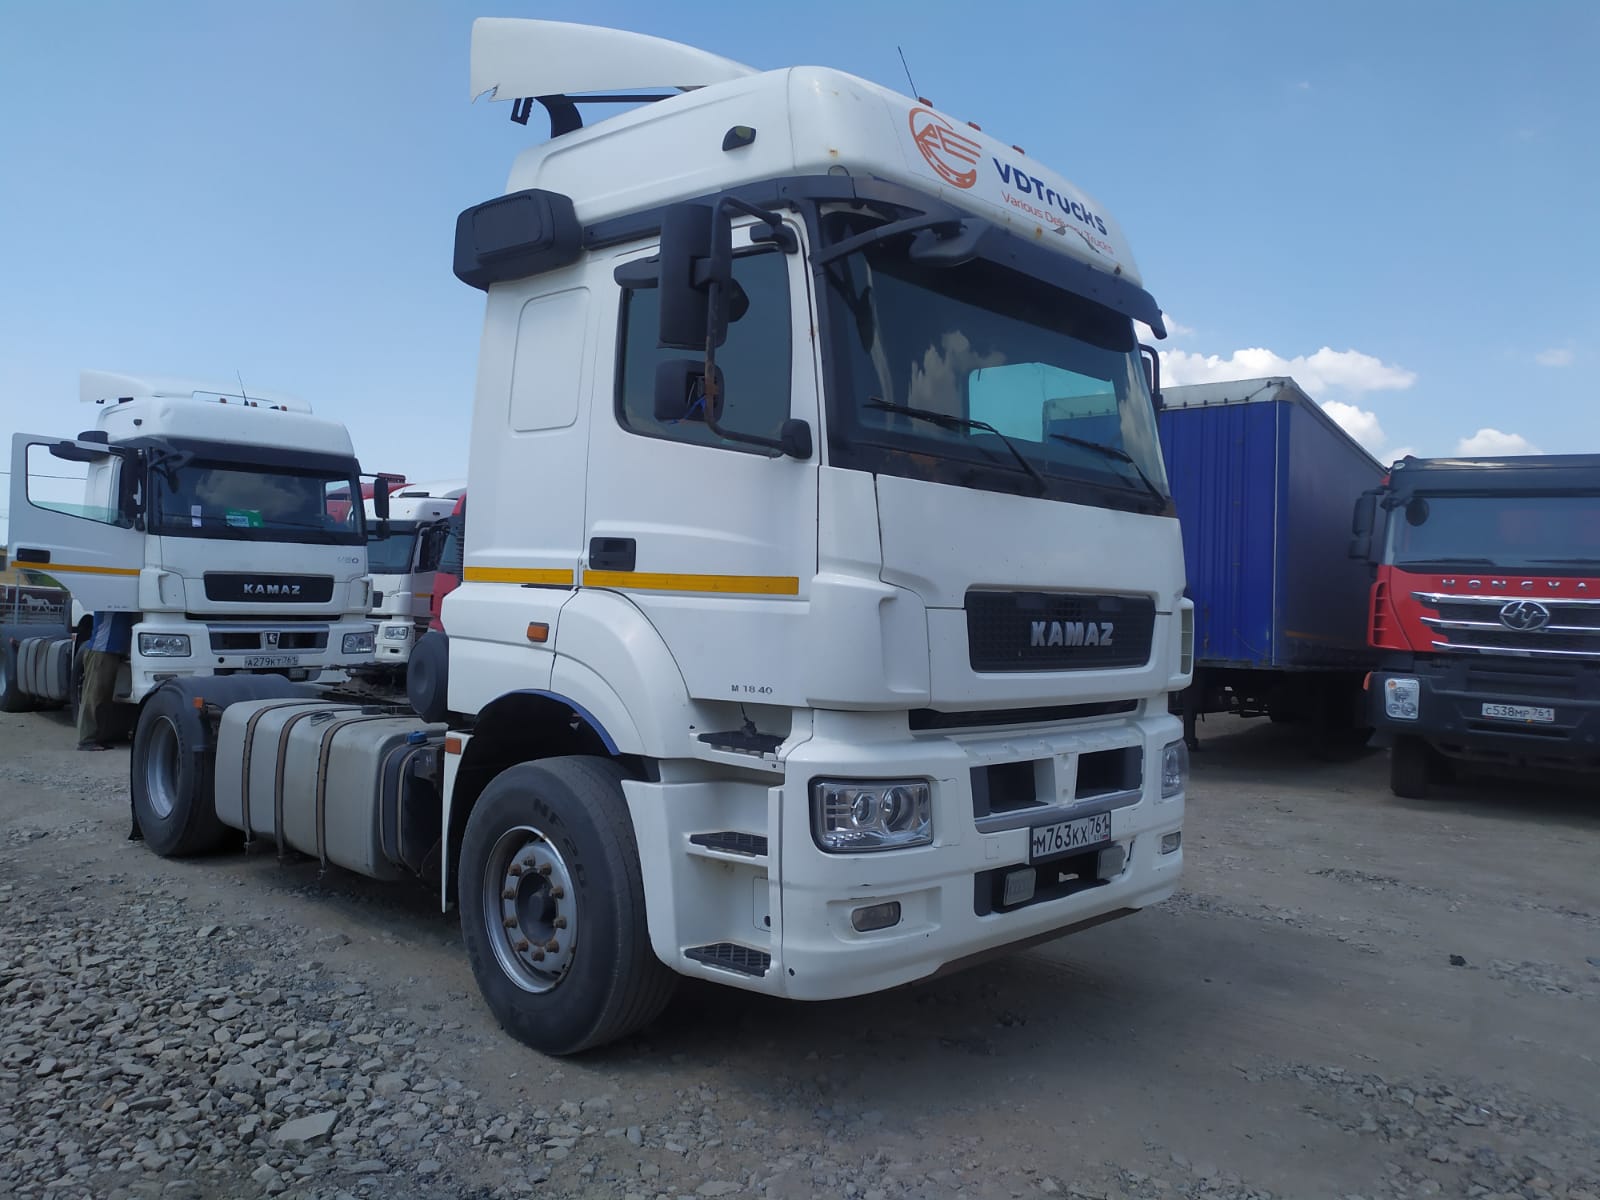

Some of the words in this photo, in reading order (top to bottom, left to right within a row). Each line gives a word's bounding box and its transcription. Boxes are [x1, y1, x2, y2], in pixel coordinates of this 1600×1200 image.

[243, 583, 301, 595] KAMAZ
[1031, 621, 1113, 647] KAMAZ
[1090, 815, 1107, 836] 761
